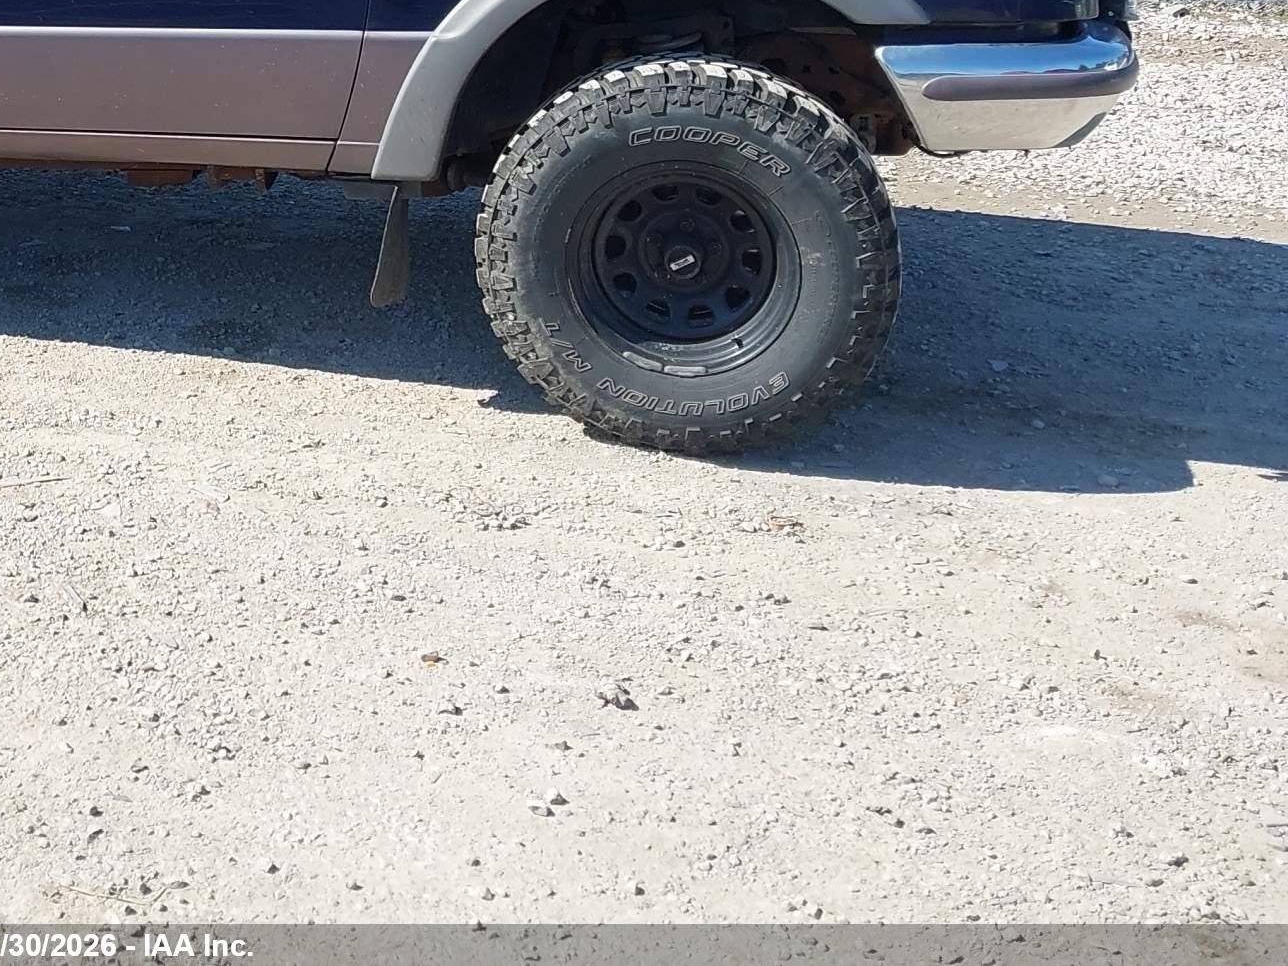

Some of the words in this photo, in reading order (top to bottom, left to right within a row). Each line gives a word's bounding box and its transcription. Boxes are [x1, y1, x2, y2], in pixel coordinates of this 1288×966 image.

[628, 125, 792, 178] COOPER
[539, 318, 592, 373] M/T
[596, 371, 791, 416] EVOLUTION
